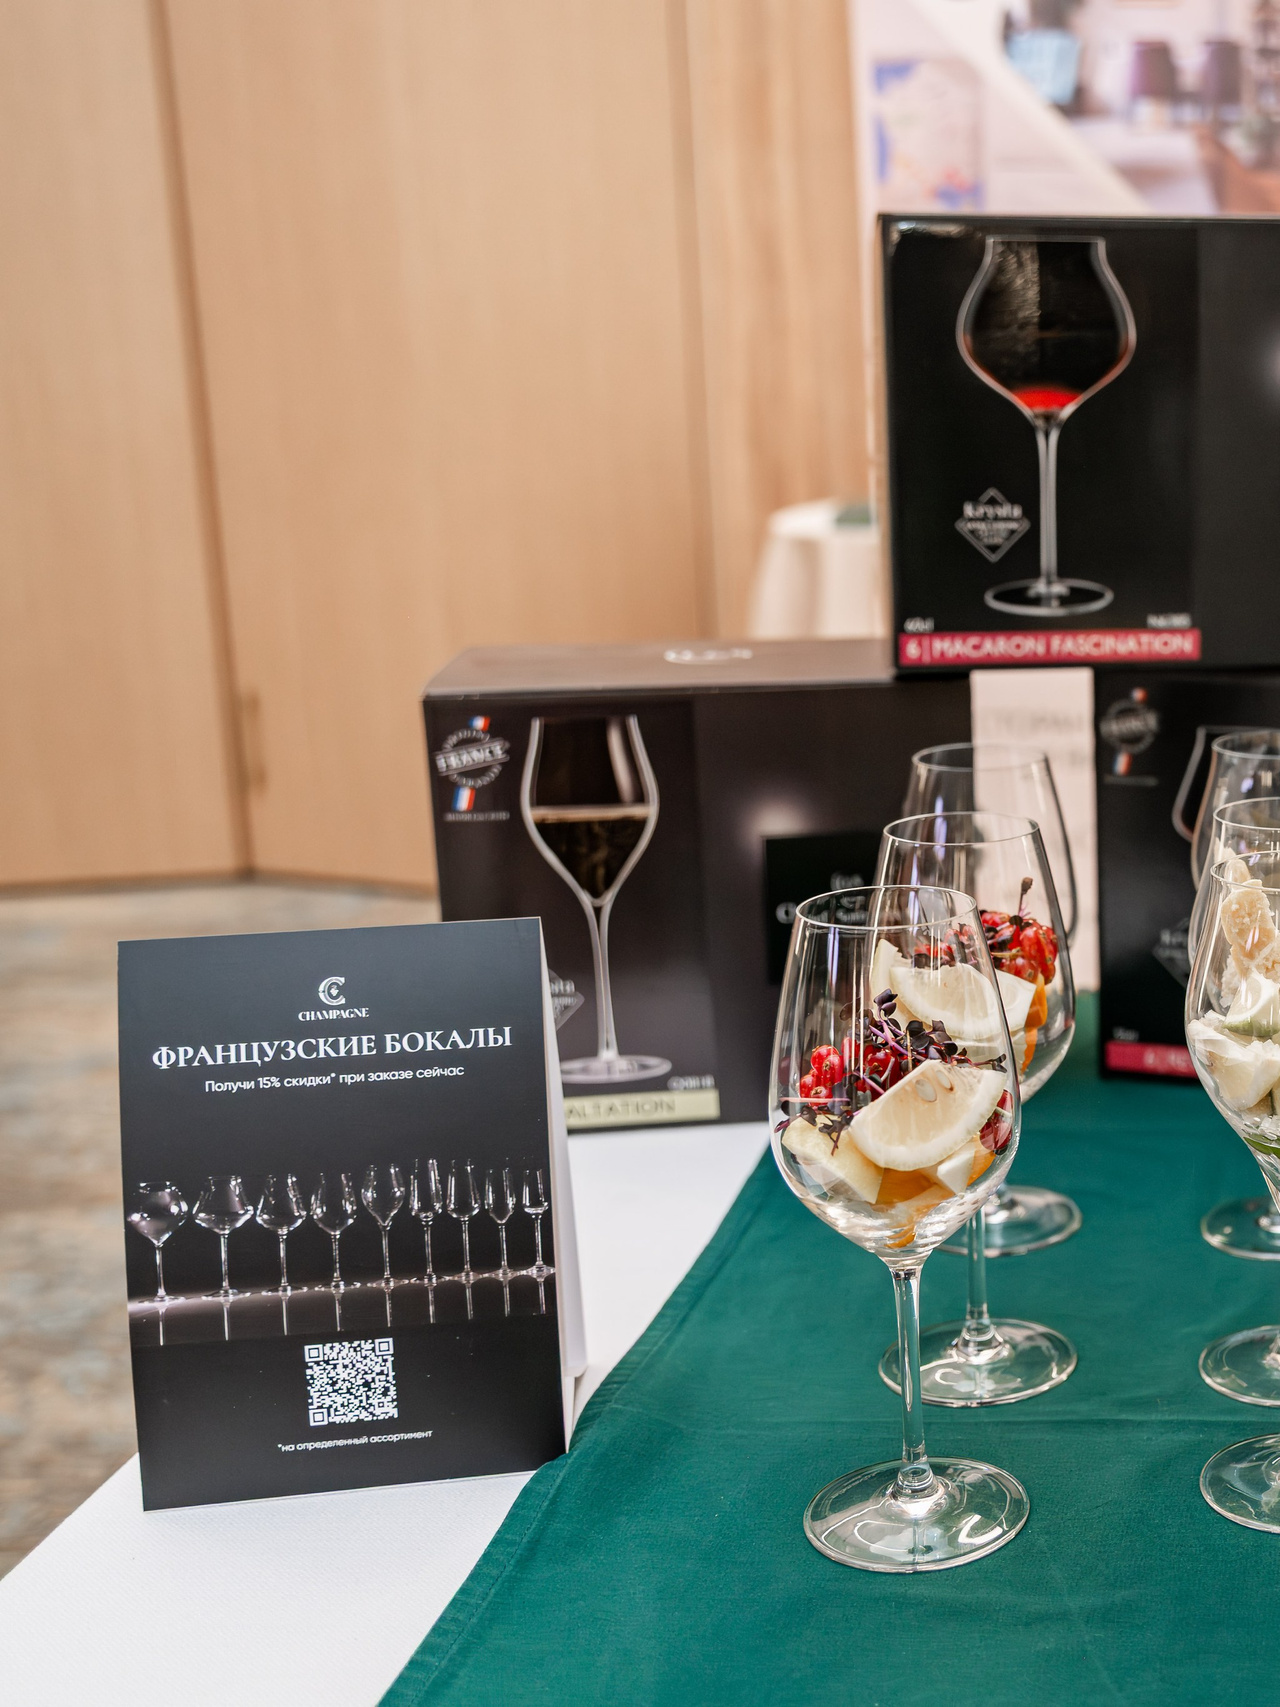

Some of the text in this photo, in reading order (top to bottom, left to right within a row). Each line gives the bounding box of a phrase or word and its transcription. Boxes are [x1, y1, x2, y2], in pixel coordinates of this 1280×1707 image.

[931, 636, 1047, 660] MACARON
[1050, 633, 1195, 658] FASCINATION
[298, 1007, 370, 1022] CHAMPAGNE
[151, 1025, 514, 1070] ФРАНЦУЗСКИЕ БОКАЛЫ
[204, 1079, 256, 1094] Получи
[257, 1076, 282, 1090] 15%
[338, 1072, 366, 1086] при
[367, 1068, 414, 1083] заказе
[415, 1063, 466, 1080] сейчас
[565, 1097, 677, 1120] ALTATION
[296, 1435, 369, 1451] определенный
[369, 1429, 434, 1444] ассортимент
